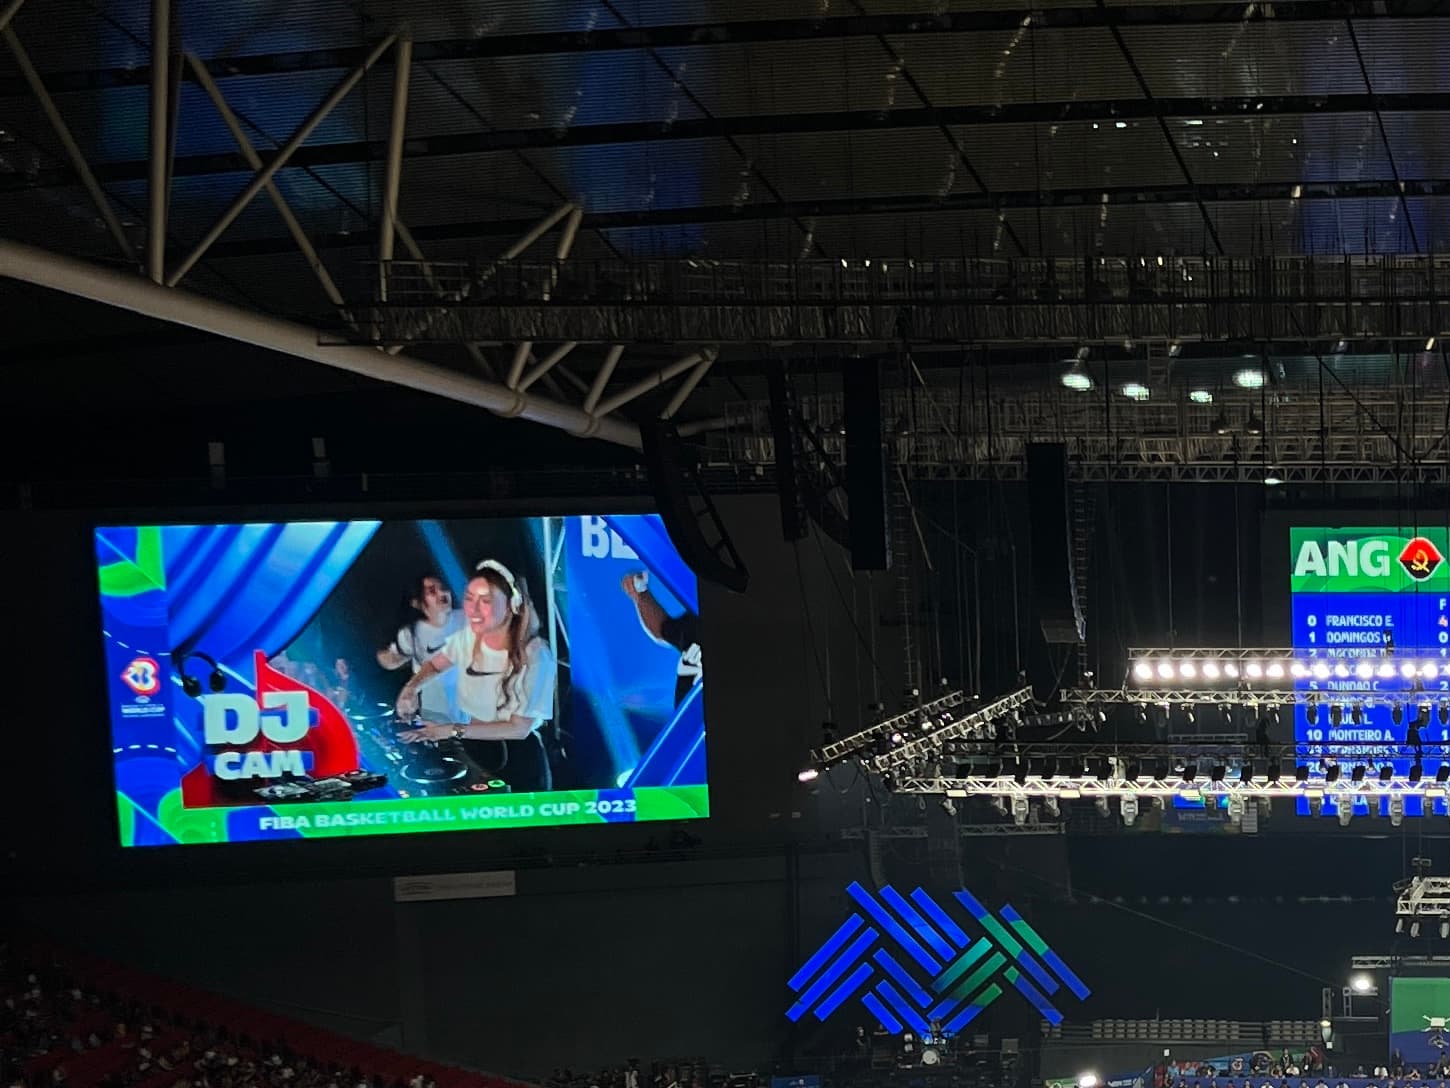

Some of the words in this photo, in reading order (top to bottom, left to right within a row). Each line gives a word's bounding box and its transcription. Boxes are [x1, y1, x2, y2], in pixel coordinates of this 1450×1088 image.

[1294, 541, 1390, 576] ANG
[1439, 599, 1447, 611] F
[1307, 615, 1317, 627] 0
[1326, 615, 1383, 627] FRANCISCO
[1309, 631, 1316, 643] 1
[1326, 632, 1381, 643] DOMINGOS
[1439, 632, 1449, 643] 0
[204, 691, 310, 744] DJ
[1307, 730, 1323, 741] 10
[1328, 729, 1382, 741] MONTEIRO
[1441, 730, 1448, 741] 1
[214, 750, 305, 779] CAM
[259, 815, 311, 830] FIBA
[315, 809, 456, 828] BASKETBALL
[461, 804, 534, 820] WORLD
[539, 801, 580, 817] CUP
[584, 799, 637, 814] 2023
